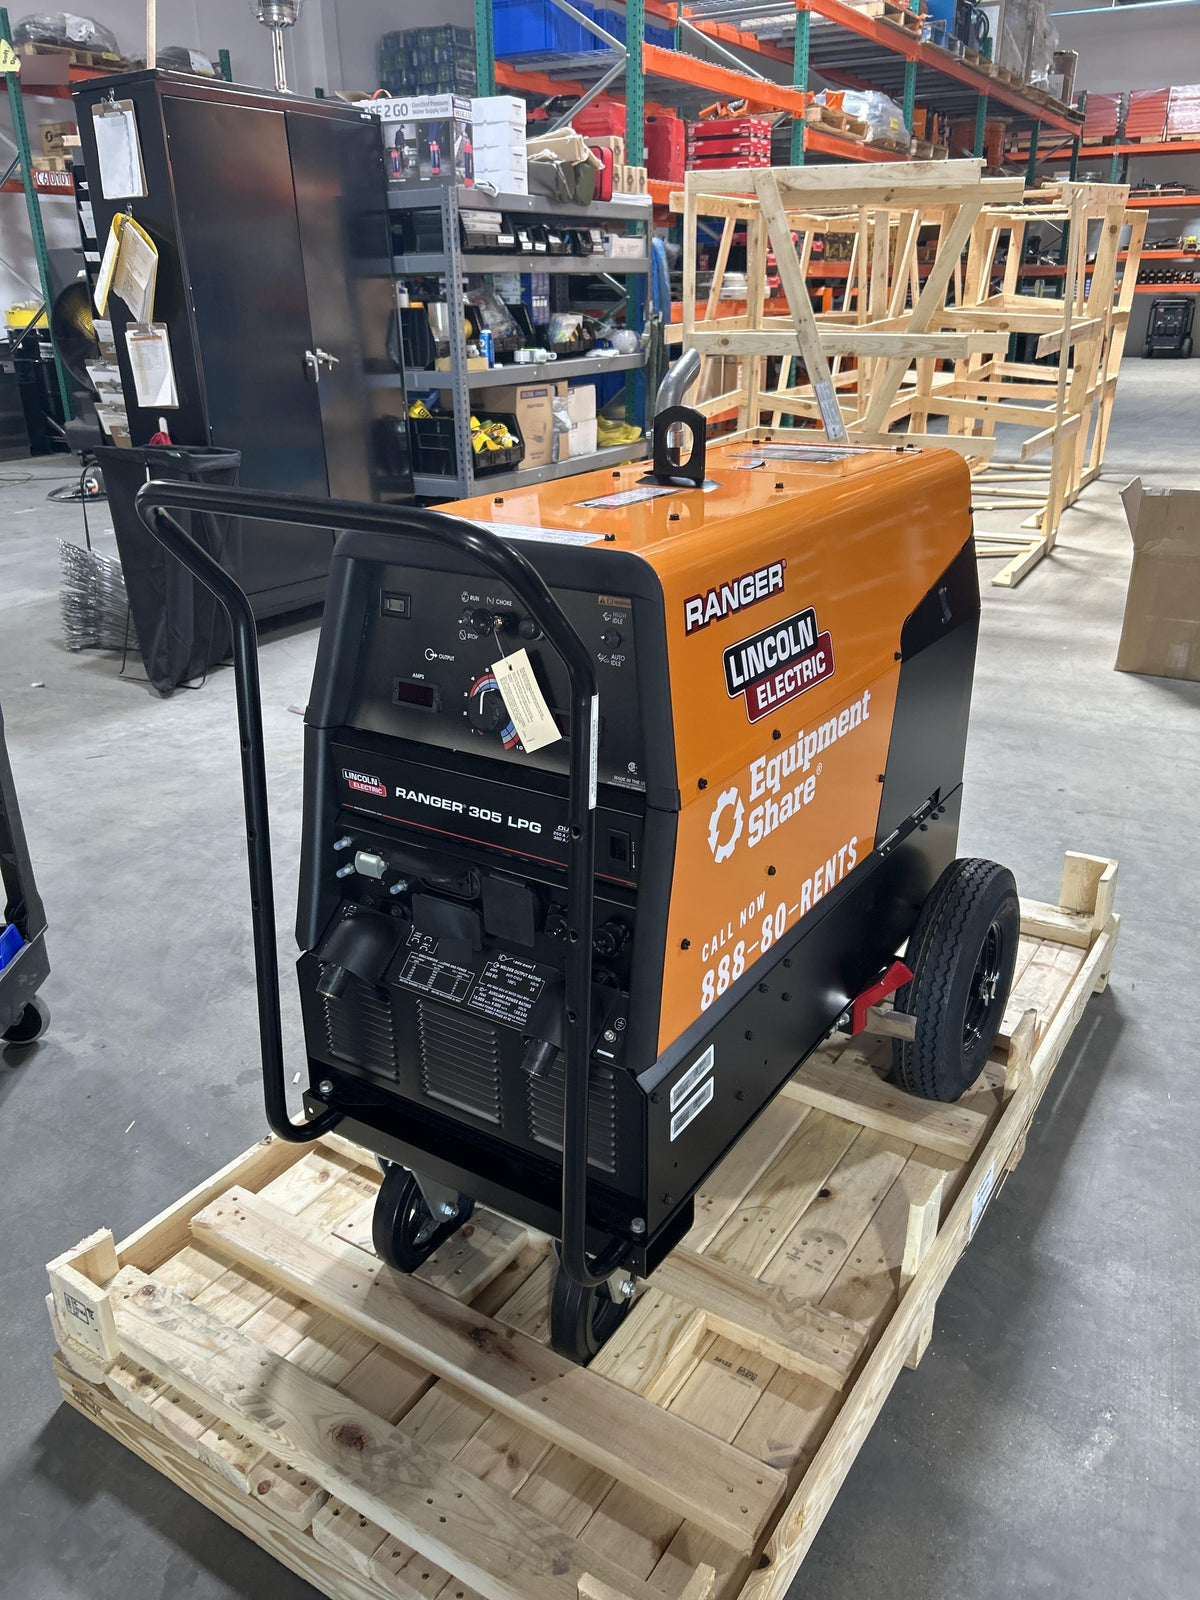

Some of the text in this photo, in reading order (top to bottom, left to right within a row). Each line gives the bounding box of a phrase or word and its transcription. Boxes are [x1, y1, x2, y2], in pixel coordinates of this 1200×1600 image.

[384, 104, 391, 117] 2
[393, 103, 408, 117] GO
[685, 563, 783, 631] RANGER
[438, 653, 455, 662] OUTPUT
[611, 654, 626, 662] AUTO
[729, 616, 814, 688] LINCOLN
[756, 650, 827, 710] ELECTRIC
[749, 689, 871, 802] Equipment
[344, 770, 378, 786] LINCOLN
[353, 782, 383, 795] ELECTRIC
[395, 786, 463, 814] RANGER
[468, 806, 502, 824] 305
[507, 815, 542, 834] LPG
[748, 774, 817, 848] Share
[700, 836, 858, 1012] 888-80-RENTS
[702, 891, 766, 962] CALL NOW
